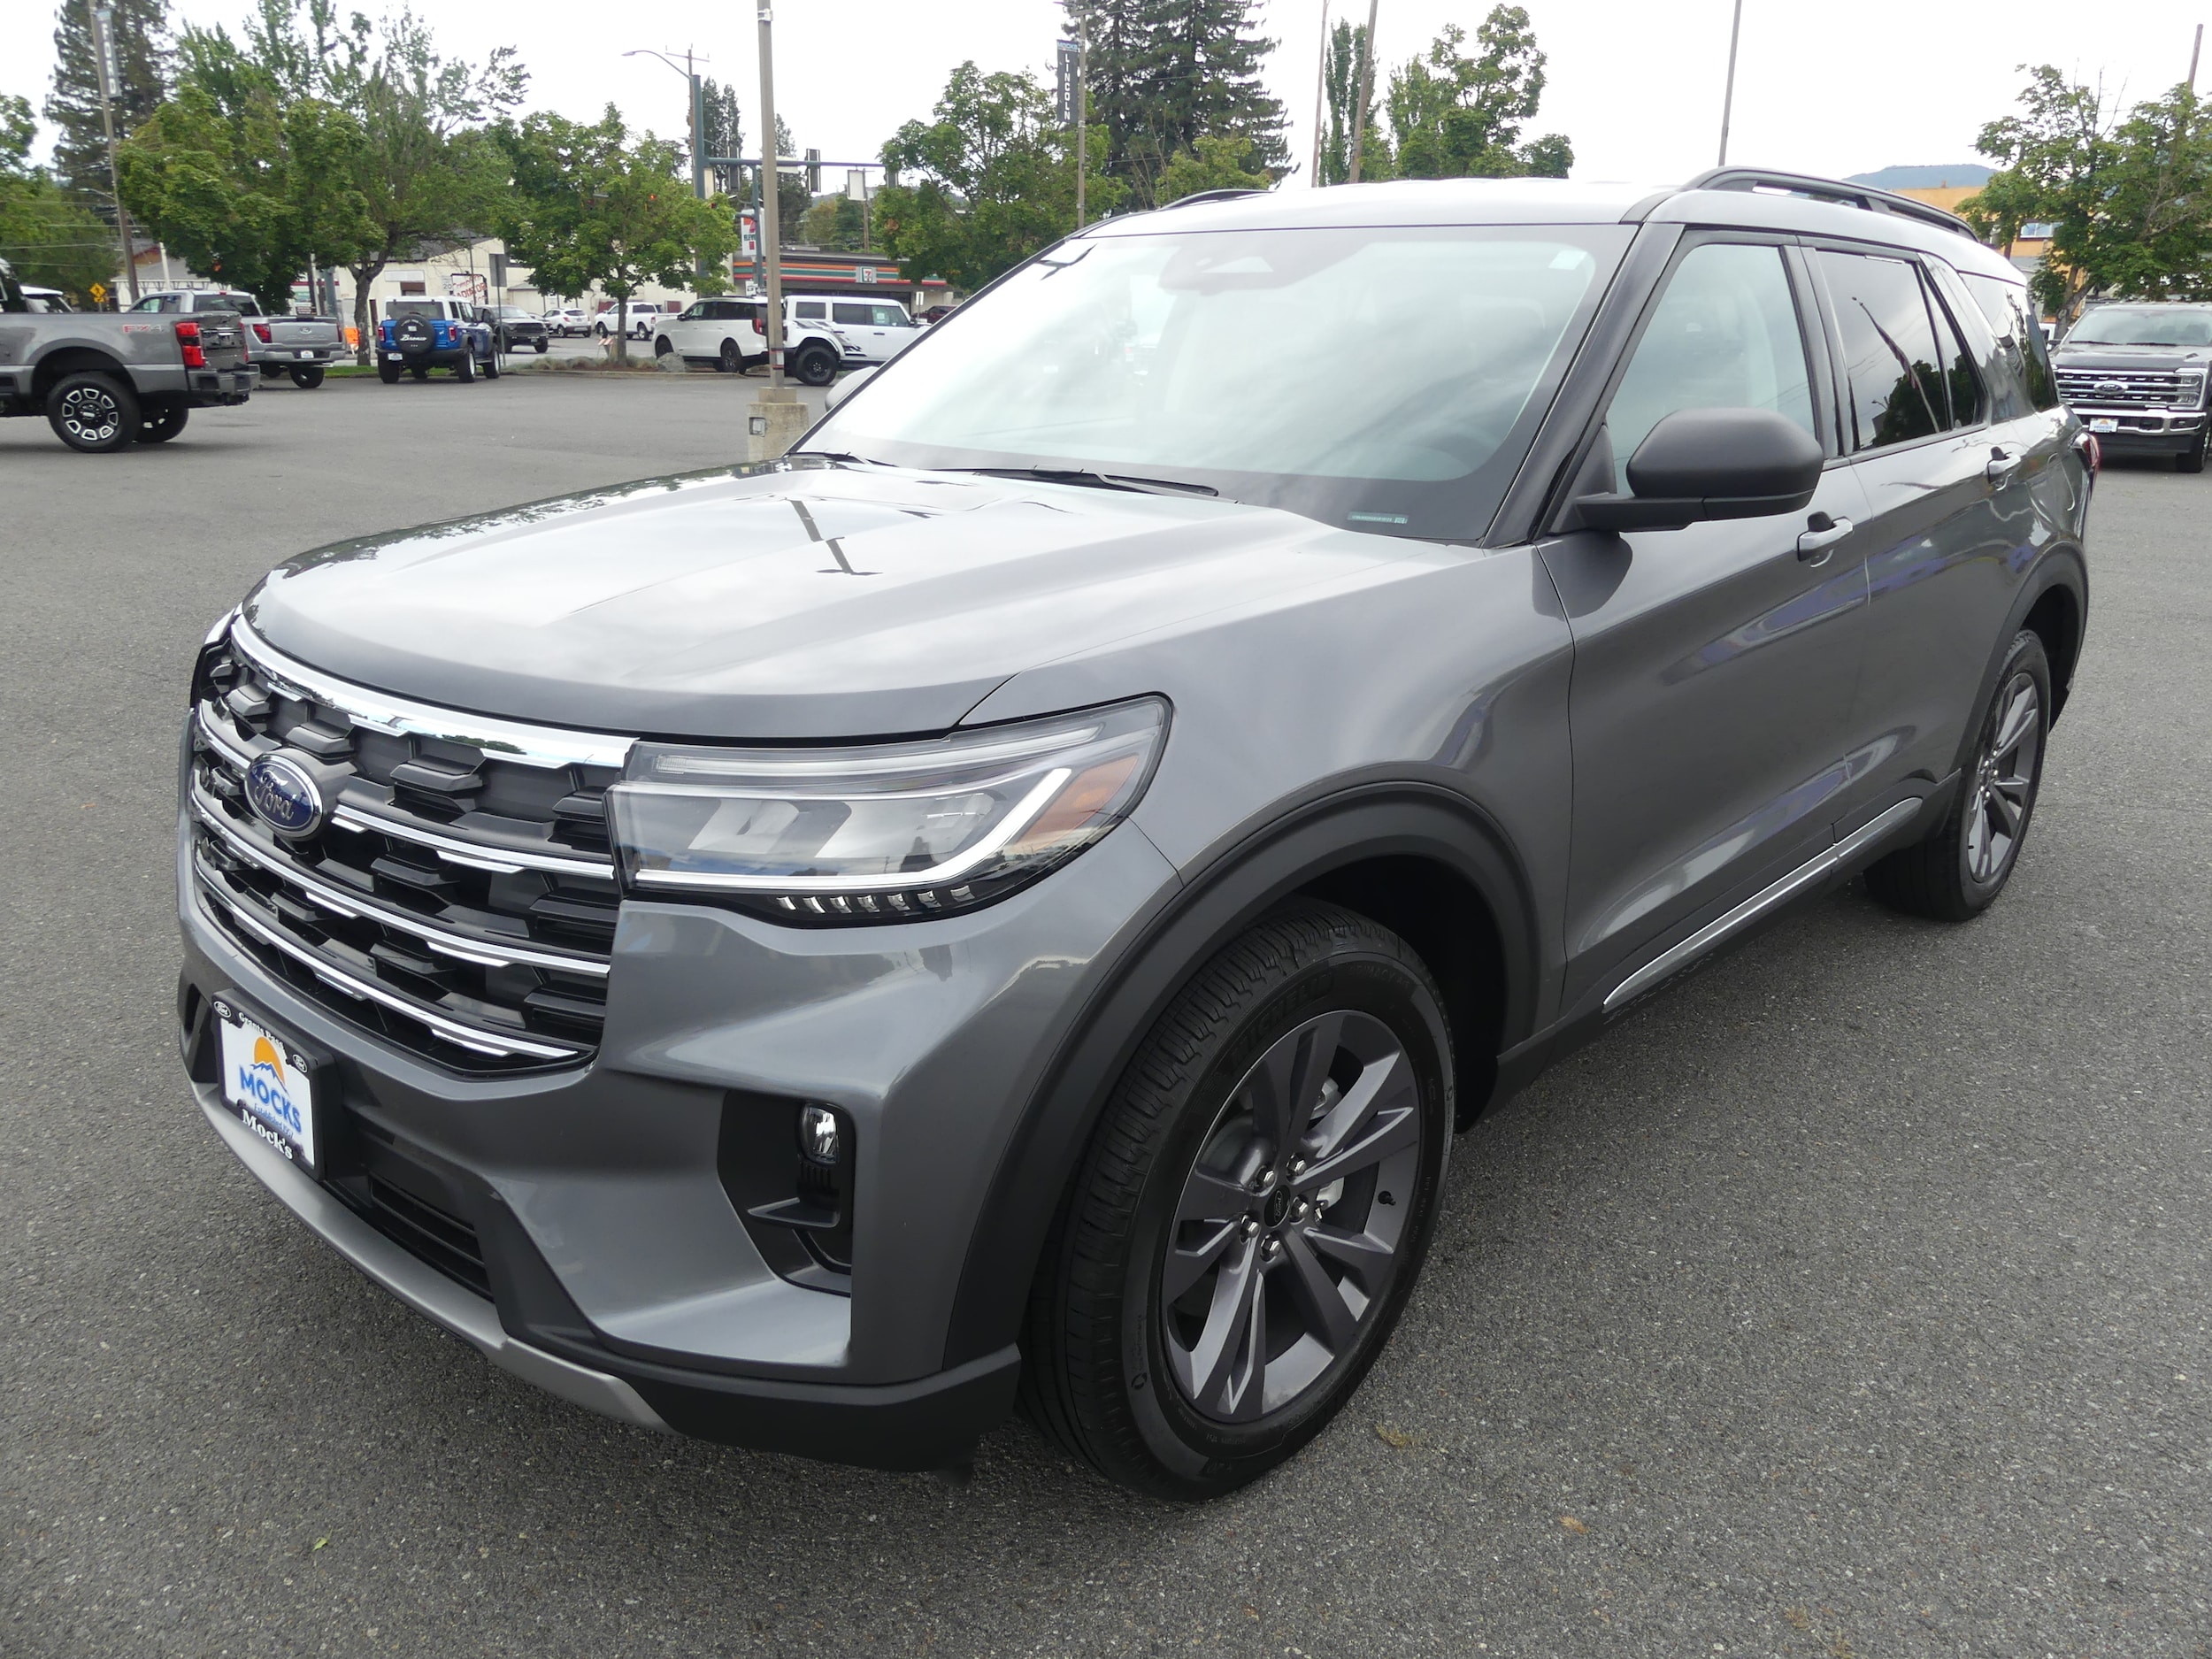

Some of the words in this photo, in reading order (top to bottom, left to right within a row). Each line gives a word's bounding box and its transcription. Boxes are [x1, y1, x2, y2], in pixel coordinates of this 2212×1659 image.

[743, 218, 756, 250] 7
[122, 324, 163, 334] FX4
[254, 771, 295, 820] Ford
[238, 1011, 265, 1036] Grants
[265, 1030, 284, 1049] Pass
[239, 1065, 302, 1133] MOCKS
[242, 1109, 294, 1160] Mock's
